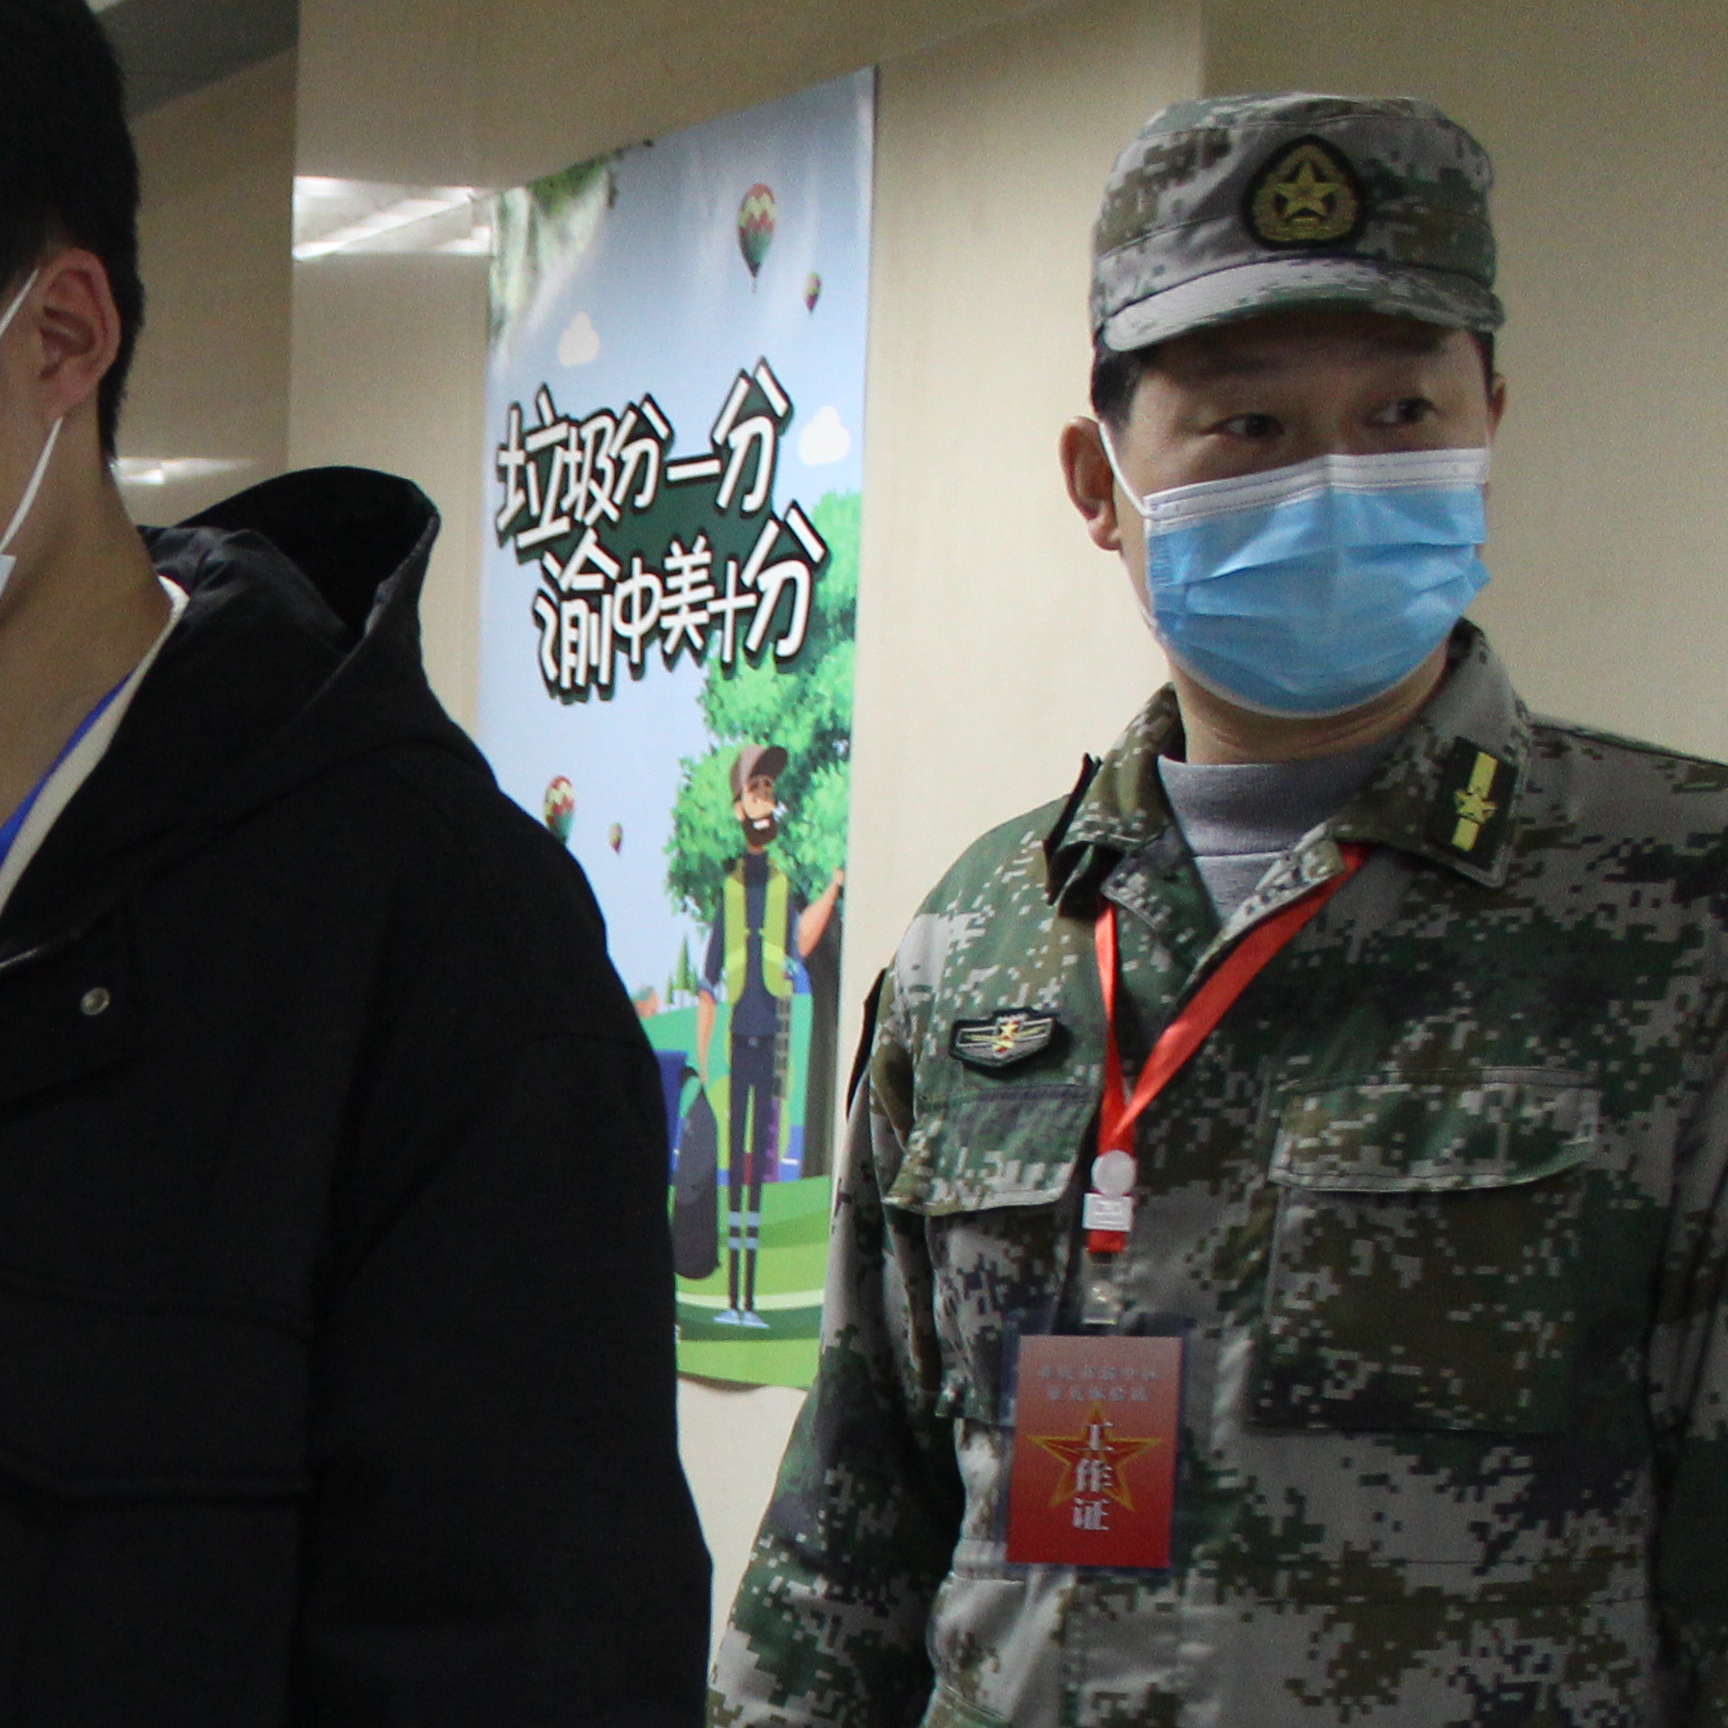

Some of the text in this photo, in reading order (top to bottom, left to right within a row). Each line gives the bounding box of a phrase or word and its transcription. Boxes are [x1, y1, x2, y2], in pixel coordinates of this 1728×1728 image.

[495, 356, 792, 550] 垃圾分一分
[534, 502, 828, 690] 渝中美十分
[1070, 1422, 1115, 1531] 工作证
